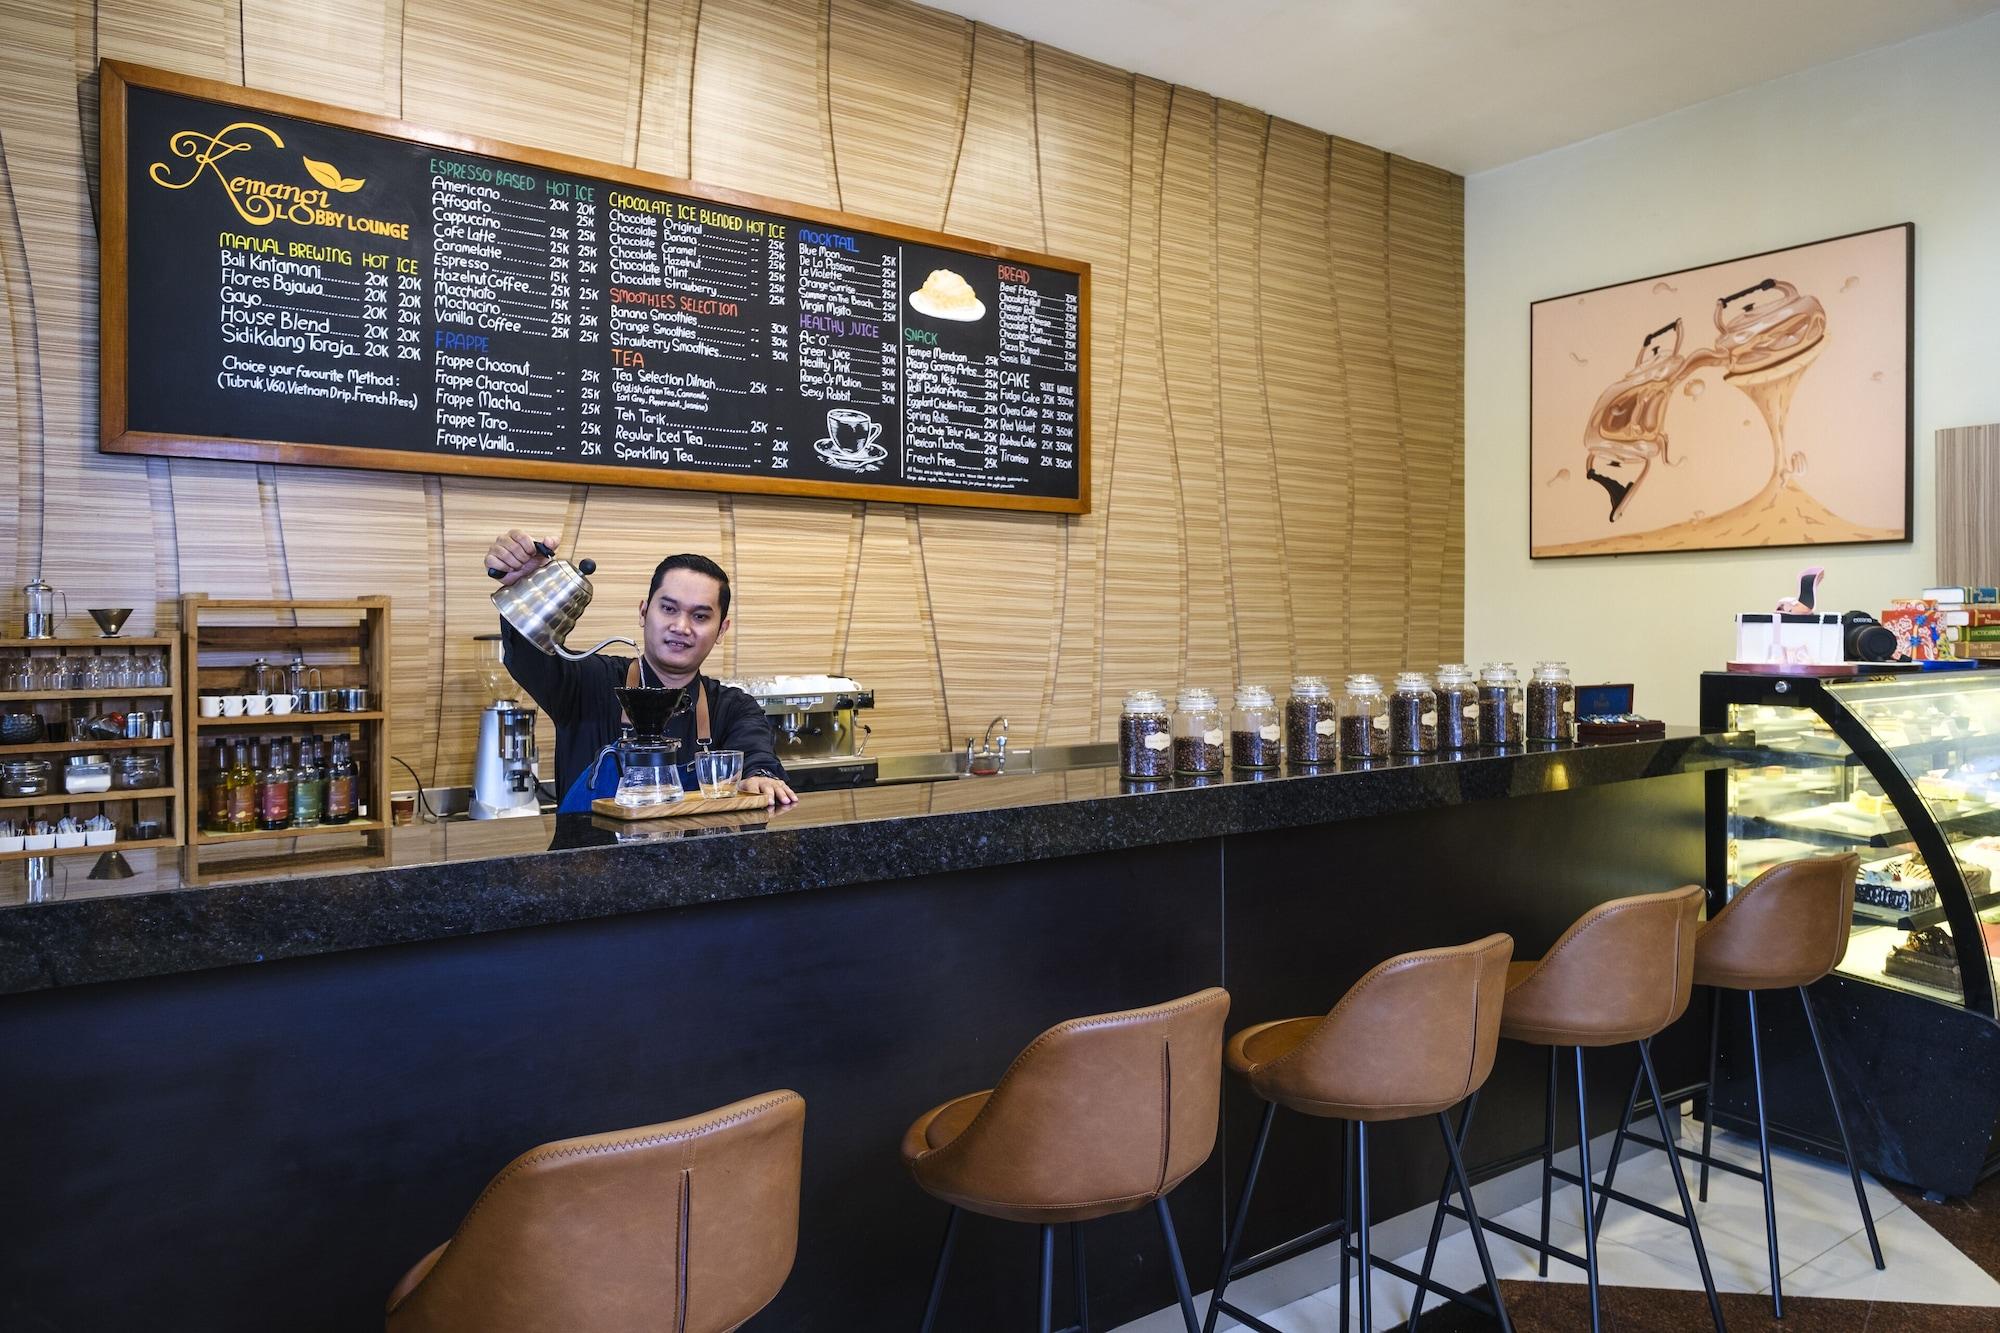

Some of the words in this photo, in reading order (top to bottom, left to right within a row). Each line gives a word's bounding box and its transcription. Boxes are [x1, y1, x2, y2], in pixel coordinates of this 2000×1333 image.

[149, 122, 332, 225] Kemangi
[429, 158, 492, 182] ESPRESSO
[496, 170, 535, 191] BASED
[546, 179, 571, 197] HOT
[575, 185, 595, 202] ICE
[432, 176, 500, 200] Americano
[549, 198, 569, 211] 20K
[576, 202, 597, 215] 20K
[432, 191, 491, 213] Affogato
[576, 215, 595, 227] 25K
[609, 192, 673, 218] CHOCOLATE
[677, 204, 697, 221] ICE
[700, 209, 742, 231] BLENDED
[746, 220, 766, 236] HOT
[768, 223, 786, 239] ICE
[347, 216, 409, 241] LOUNGE
[432, 207, 500, 229] Cappuccino
[549, 226, 569, 240] 25K
[577, 229, 596, 242] 25K
[433, 223, 465, 238] Cafe
[467, 227, 496, 243] Latte
[609, 209, 657, 227] Chocolate
[662, 218, 702, 235] Original
[609, 222, 657, 237] Chocolate
[663, 230, 697, 245] Banana
[433, 239, 502, 259] Caramelatte
[609, 233, 655, 249] Chocolate
[661, 242, 697, 256] Caramel
[799, 229, 860, 252] MOCKTAIL
[219, 232, 284, 256] MANUAL
[289, 242, 352, 265] BREWING
[362, 252, 389, 270] HOT
[396, 257, 418, 275] ICE
[609, 246, 658, 261] Chocolate
[662, 254, 701, 270] Hazelnut
[799, 243, 817, 255] Blue
[819, 246, 840, 259] Moon
[882, 255, 896, 266] 25K
[800, 256, 810, 266] De
[221, 250, 245, 267] Bali
[250, 253, 321, 279] Kintamani
[364, 271, 389, 287] 20K
[398, 275, 422, 291] 20K
[433, 252, 489, 271] Espresso
[550, 271, 568, 284] 15K
[434, 268, 487, 284] Hazelnut
[487, 274, 529, 293] Coffee
[610, 258, 660, 274] Chocolate
[665, 265, 689, 278] Mint
[799, 266, 809, 277] Le
[810, 267, 842, 280] Violette
[998, 264, 1030, 284] BREAD
[221, 268, 270, 289] Flores
[273, 275, 323, 295] Bajawa
[364, 288, 388, 303] 20K
[398, 293, 421, 308] 20K
[434, 281, 496, 300] Macchiato
[551, 299, 568, 310] 15K
[611, 271, 662, 286] Chocolate
[664, 278, 717, 297] Strawberry
[799, 277, 829, 291] Orange
[829, 282, 856, 294] Sunrise
[220, 286, 262, 308] Gayo
[362, 305, 388, 320] 20K
[397, 309, 421, 325] 20K
[434, 295, 500, 315] Mochacino
[609, 288, 676, 309] SMOOTHIES
[680, 296, 738, 317] SELECTION
[799, 299, 824, 313] Virgin
[221, 305, 275, 326] House
[281, 311, 330, 334] Blend
[364, 324, 389, 340] 20K
[397, 328, 420, 343] 20K
[434, 308, 473, 325] Vanilla
[478, 314, 521, 332] Coffee
[610, 305, 647, 319] Banana
[650, 309, 697, 326] Smoothies
[770, 323, 788, 335] 30K
[800, 313, 844, 337] HEALTHY
[849, 322, 879, 338] JUICE
[435, 330, 489, 353] FRAPPE
[610, 319, 649, 333] Orange
[653, 323, 696, 339] Smoothies
[771, 336, 787, 348] 30K
[904, 328, 938, 345] SNACK
[305, 333, 354, 358] Toraja
[364, 342, 389, 358] 20K
[397, 345, 421, 361] 20K
[610, 332, 670, 353] Strawberry
[672, 339, 719, 358] Smoothies
[772, 350, 788, 362] 30K
[612, 349, 645, 368] TEA
[799, 342, 826, 356] Green
[828, 349, 850, 360] Juice
[882, 355, 896, 365] 30K
[905, 345, 932, 360] Tempe
[222, 355, 266, 372] Choice
[269, 362, 296, 376] your
[296, 365, 344, 382] favourite
[435, 351, 474, 371] Frappe
[476, 357, 530, 377] Choconut
[581, 369, 600, 383] 25K
[800, 355, 831, 372] Healthy
[834, 359, 850, 373] Pink
[435, 369, 473, 390] Frappe
[476, 375, 529, 395] Charcoal
[612, 368, 632, 382] Tea
[638, 369, 684, 386] Selection
[686, 373, 716, 390] Dilmah
[750, 381, 767, 394] 25K
[800, 384, 824, 400] Sexy
[1000, 371, 1030, 389] CAKE
[435, 388, 474, 409] Frappe
[478, 390, 521, 412] Macha
[436, 409, 476, 429] Frappe
[478, 412, 508, 430] Taro
[581, 422, 601, 436] 25K
[614, 407, 636, 421] Teh
[750, 420, 768, 433] 25K
[906, 409, 931, 424] Spring
[1000, 418, 1014, 431] Red
[436, 429, 477, 450] Frappe
[478, 433, 515, 452] Vanilla
[581, 441, 601, 455] 25K
[615, 424, 653, 442] Regular
[656, 428, 680, 443] Iced
[682, 430, 703, 446] Tea
[773, 439, 788, 452] 20K
[673, 448, 694, 463] Tea
[772, 456, 788, 469] 25K
[906, 448, 935, 465] French
[937, 453, 956, 467] Fries
